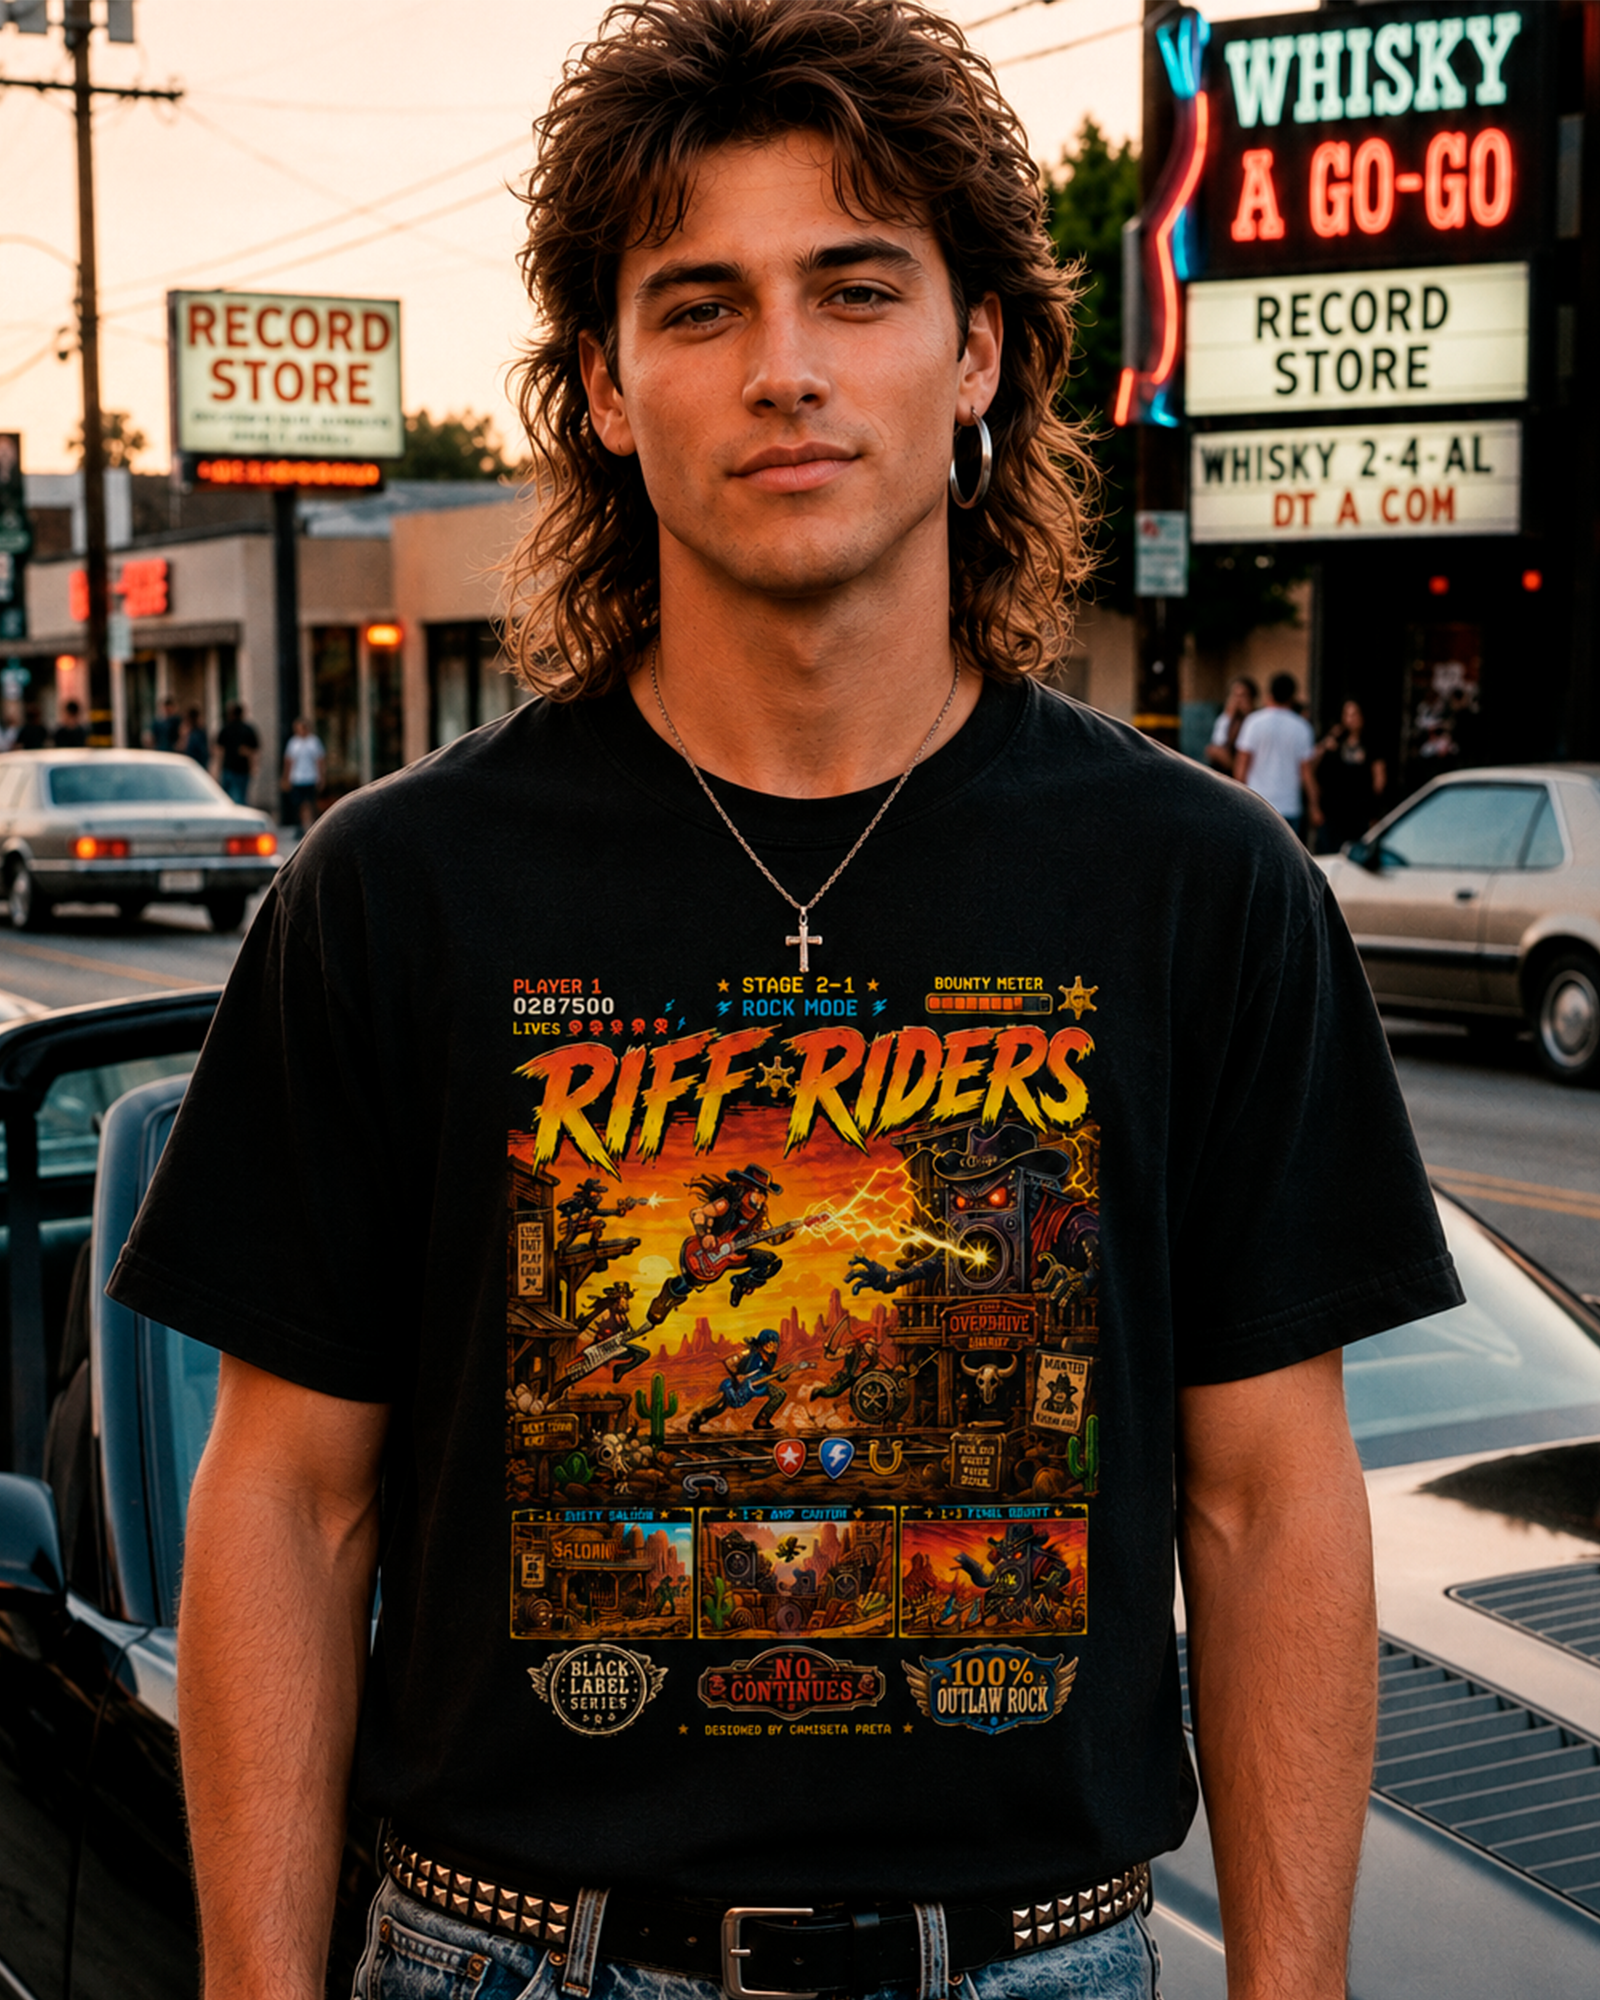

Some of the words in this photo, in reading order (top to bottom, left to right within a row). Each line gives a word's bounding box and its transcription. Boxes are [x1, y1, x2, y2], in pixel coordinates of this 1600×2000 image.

[1224, 11, 1521, 129] WHISKY
[1231, 148, 1286, 242] A
[1308, 127, 1514, 239] GO-GO
[1256, 286, 1449, 339] RECORD
[187, 302, 393, 354] RECORD
[211, 357, 373, 406] STORE
[1275, 345, 1430, 396] STORE
[1202, 442, 1336, 485] WHISKY
[1273, 492, 1316, 528] DT
[1338, 490, 1359, 525] A
[1380, 487, 1456, 525] COM
[513, 978, 583, 995] PLAYER
[591, 978, 602, 994] 1
[742, 976, 804, 994] STAGE
[816, 976, 855, 994] 2-1
[934, 976, 991, 991] BOUNTY
[996, 976, 1044, 991] METER
[742, 998, 795, 1017] ROCK
[804, 998, 858, 1017] MODE
[512, 1021, 561, 1035] LIVES
[511, 1024, 782, 1181] RIFF
[780, 1025, 1095, 1160] RIDERS
[570, 1660, 630, 1677] BLACK
[775, 1657, 812, 1680] NO
[951, 1657, 1034, 1686] 100%
[569, 1677, 630, 1695] LABEL
[731, 1680, 853, 1702] CONTINUES
[937, 1686, 1003, 1714] OUTLAW
[1008, 1686, 1049, 1713] ROCK
[767, 1724, 783, 1736] BY
[789, 1723, 849, 1736] CAMISETA
[855, 1723, 892, 1735] PRETA
